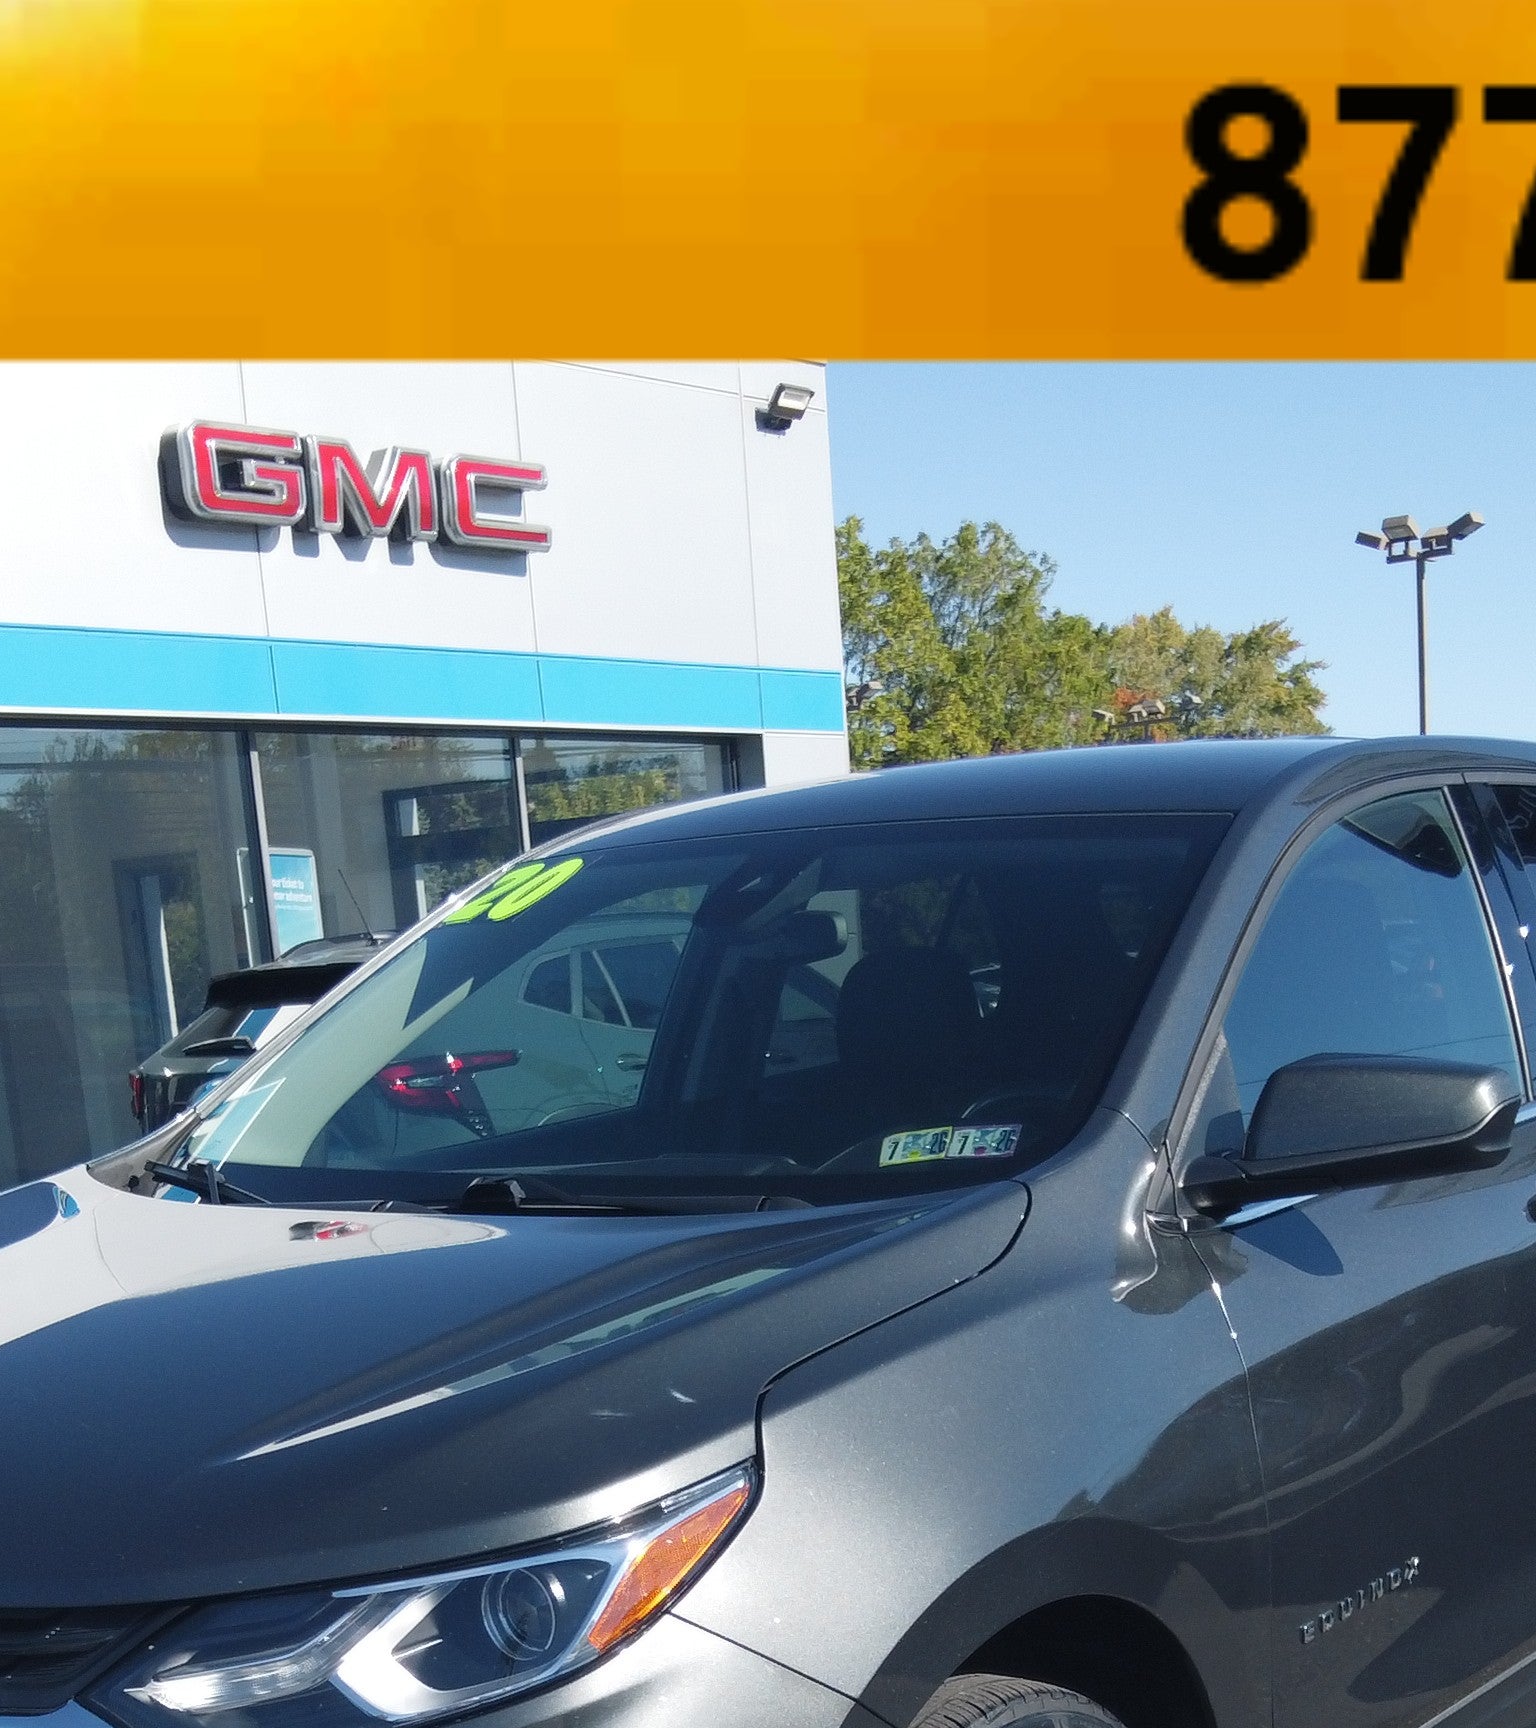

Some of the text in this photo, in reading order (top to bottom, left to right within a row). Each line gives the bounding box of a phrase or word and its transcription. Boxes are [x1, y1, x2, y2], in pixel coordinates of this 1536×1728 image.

[164, 419, 551, 553] GMC
[888, 1141, 900, 1160] 7
[958, 1135, 969, 1155] 7
[1300, 1556, 1420, 1645] EQUINOX
